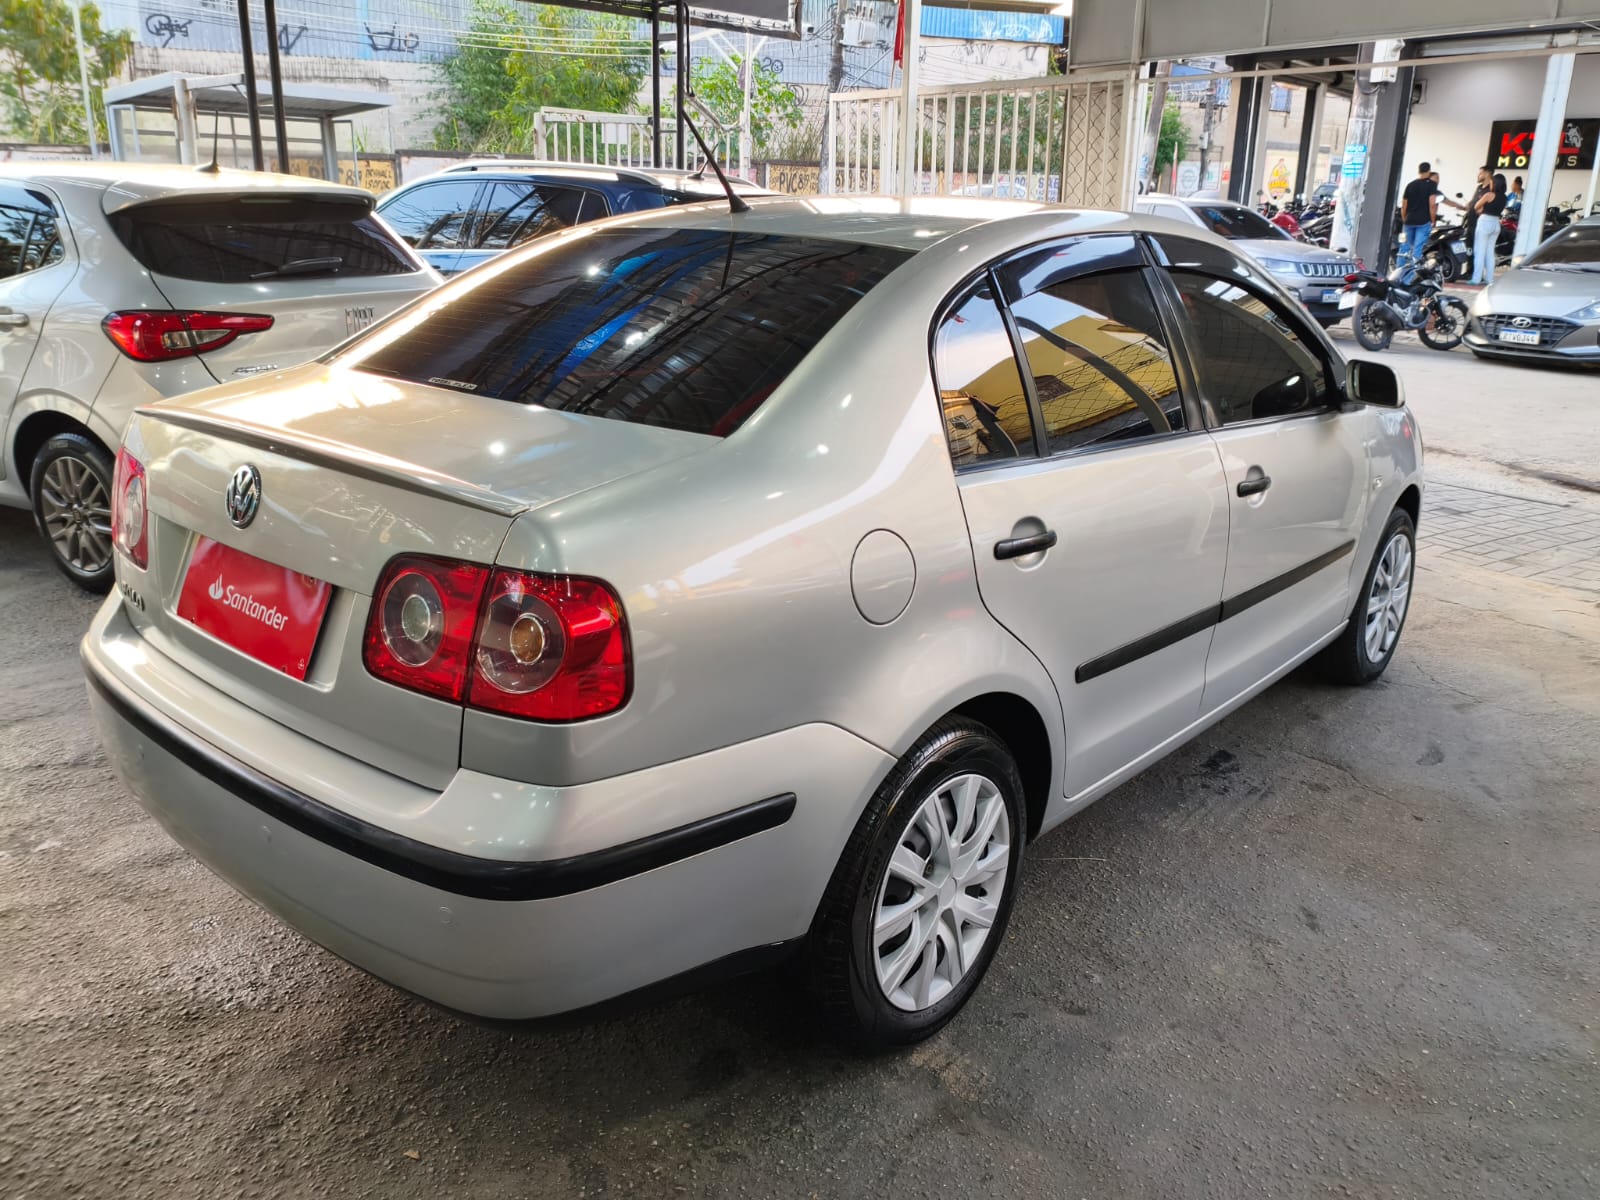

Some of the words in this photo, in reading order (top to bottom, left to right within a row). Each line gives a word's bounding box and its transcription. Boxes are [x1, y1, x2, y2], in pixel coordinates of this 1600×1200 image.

[1501, 132, 1580, 156] KL
[1497, 155, 1578, 168] MOS
[780, 172, 799, 194] PVC
[223, 585, 289, 632] Santander
